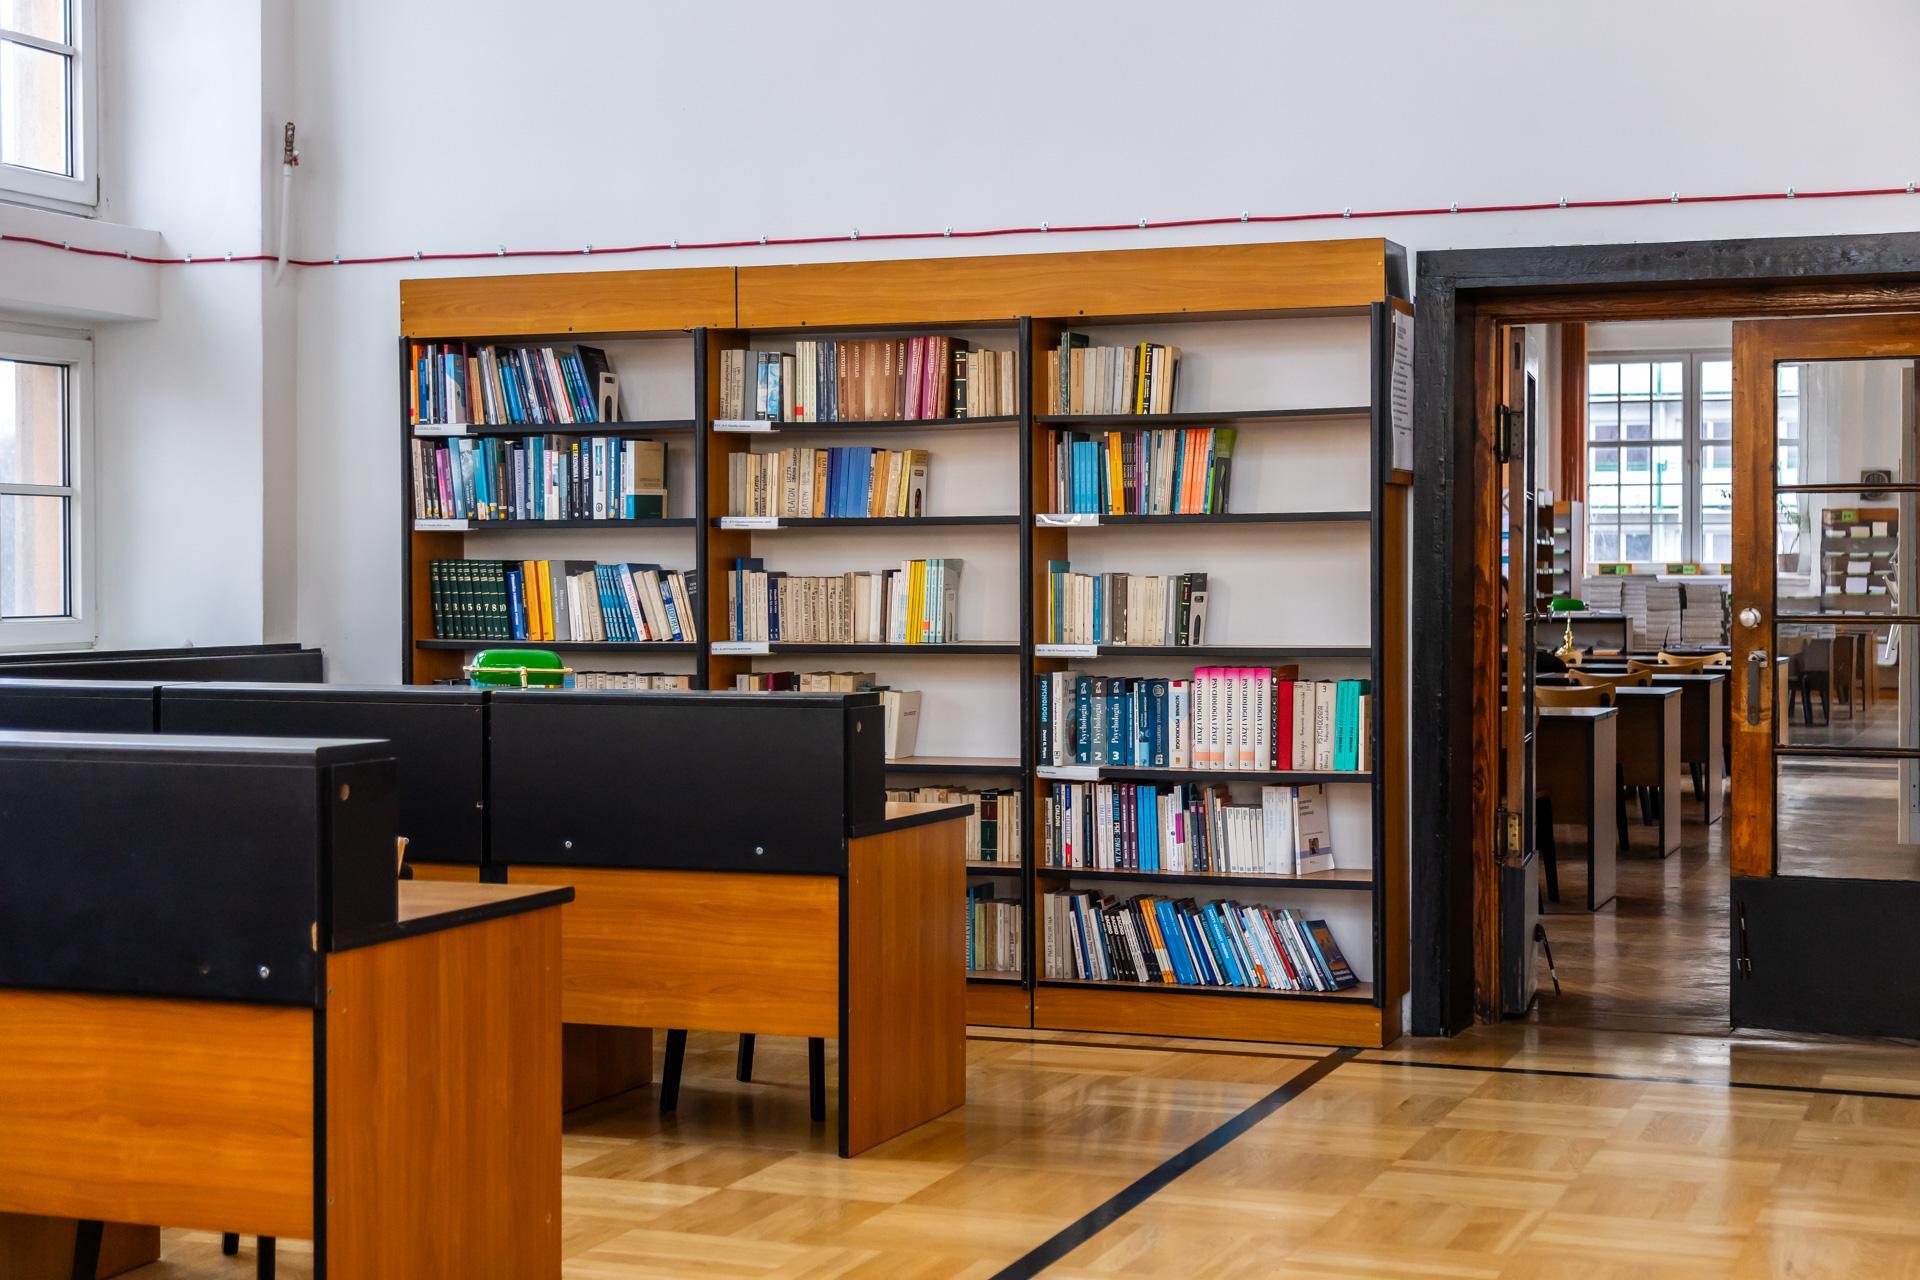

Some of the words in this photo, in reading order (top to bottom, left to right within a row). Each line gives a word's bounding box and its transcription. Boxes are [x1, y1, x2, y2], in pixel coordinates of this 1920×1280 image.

[787, 487, 796, 513] PLATON
[434, 603, 439, 611] 1
[444, 603, 449, 611] 2
[452, 603, 458, 611] 3
[467, 603, 473, 611] 5
[476, 603, 482, 611] 6
[484, 603, 490, 611] 7
[491, 603, 497, 611] 8
[499, 603, 507, 611] 10
[1079, 704, 1089, 744] Psychologia
[1093, 703, 1104, 744] Psychologia
[1111, 703, 1121, 743] Psychologia
[1211, 726, 1219, 745] ŻYCIE
[1226, 727, 1234, 746] ŻYCIE
[1241, 727, 1249, 746] ŻYCIE
[1080, 752, 1087, 761] 1
[1095, 751, 1102, 760] 2
[1113, 751, 1119, 760] 3
